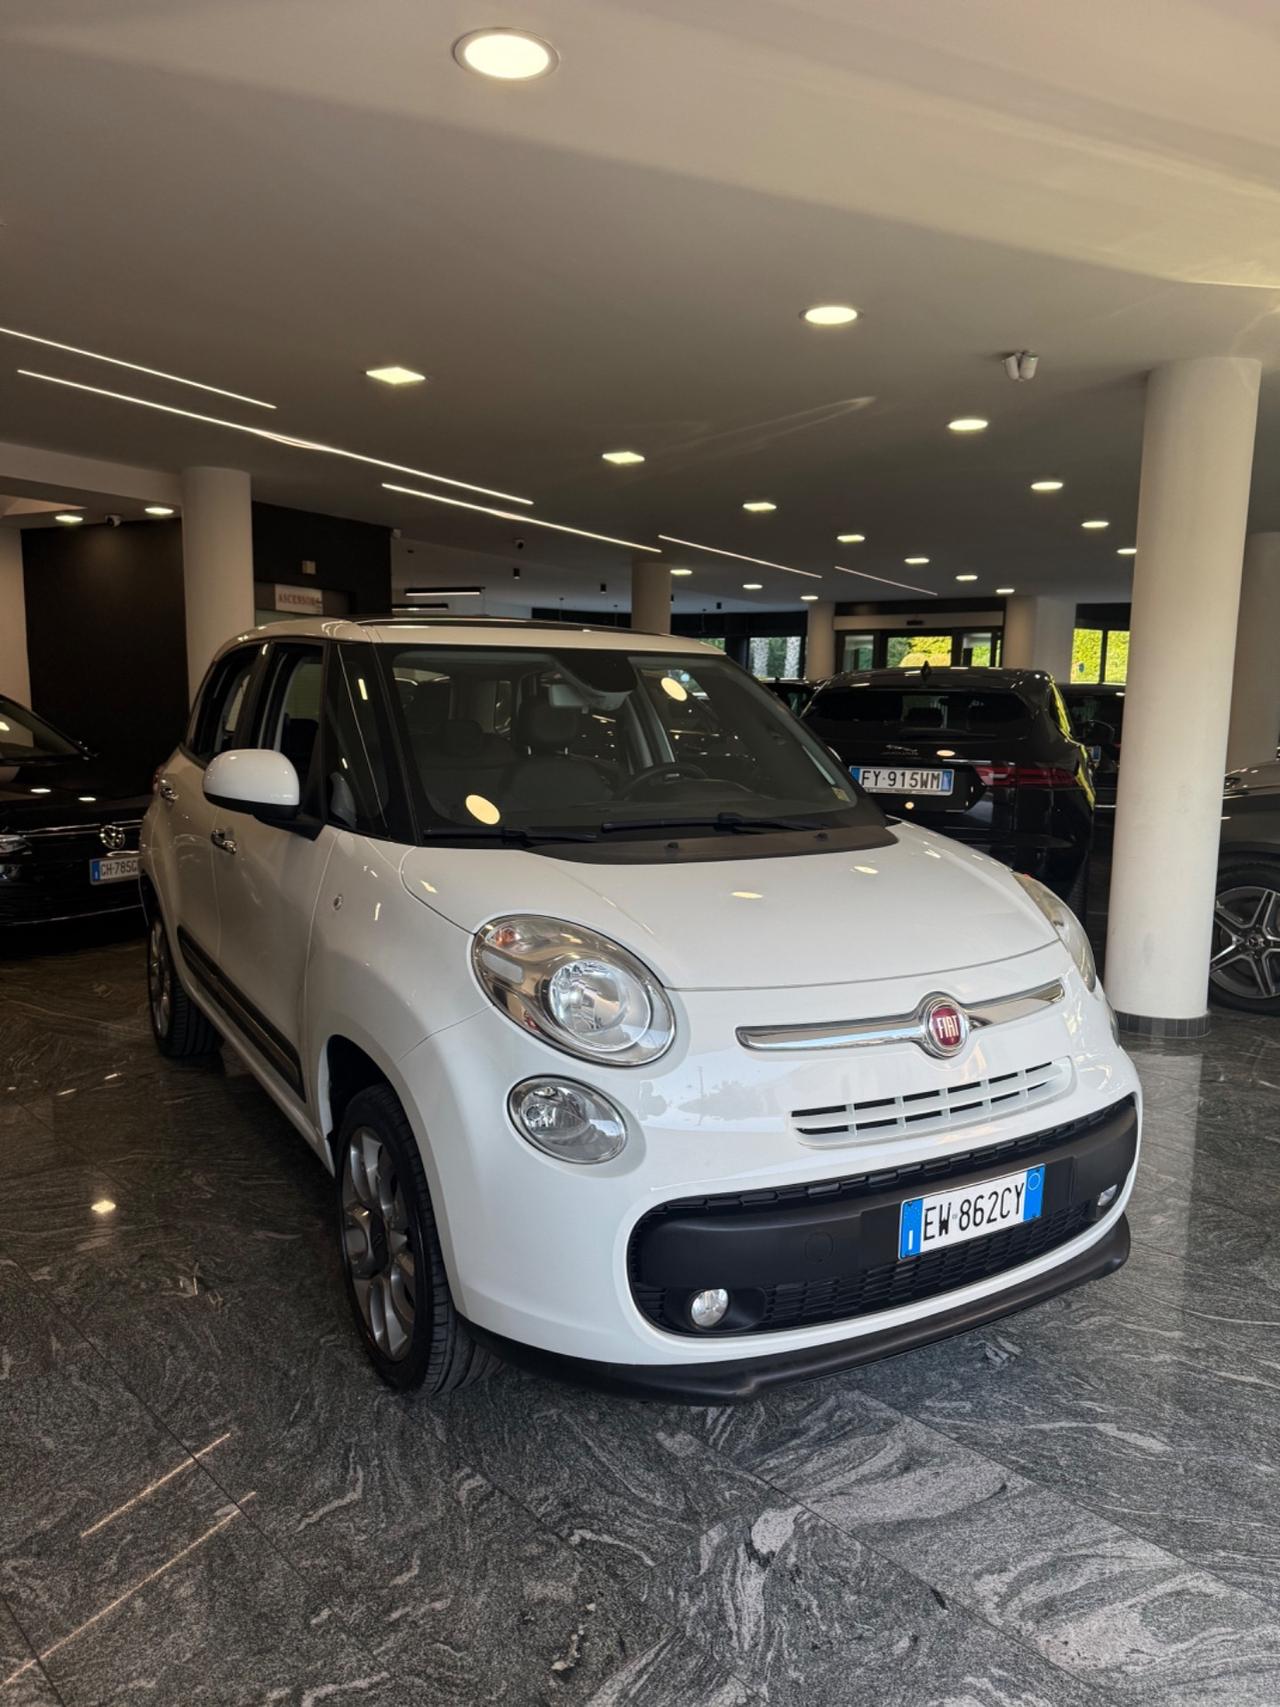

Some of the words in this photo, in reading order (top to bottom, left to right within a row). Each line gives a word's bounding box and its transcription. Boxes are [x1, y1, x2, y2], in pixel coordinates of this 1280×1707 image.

[861, 770, 881, 786] FY
[887, 771, 940, 789] 915WM
[936, 1015, 959, 1039] FIAT
[923, 1202, 952, 1241] EW
[958, 1182, 1025, 1232] 862CY
